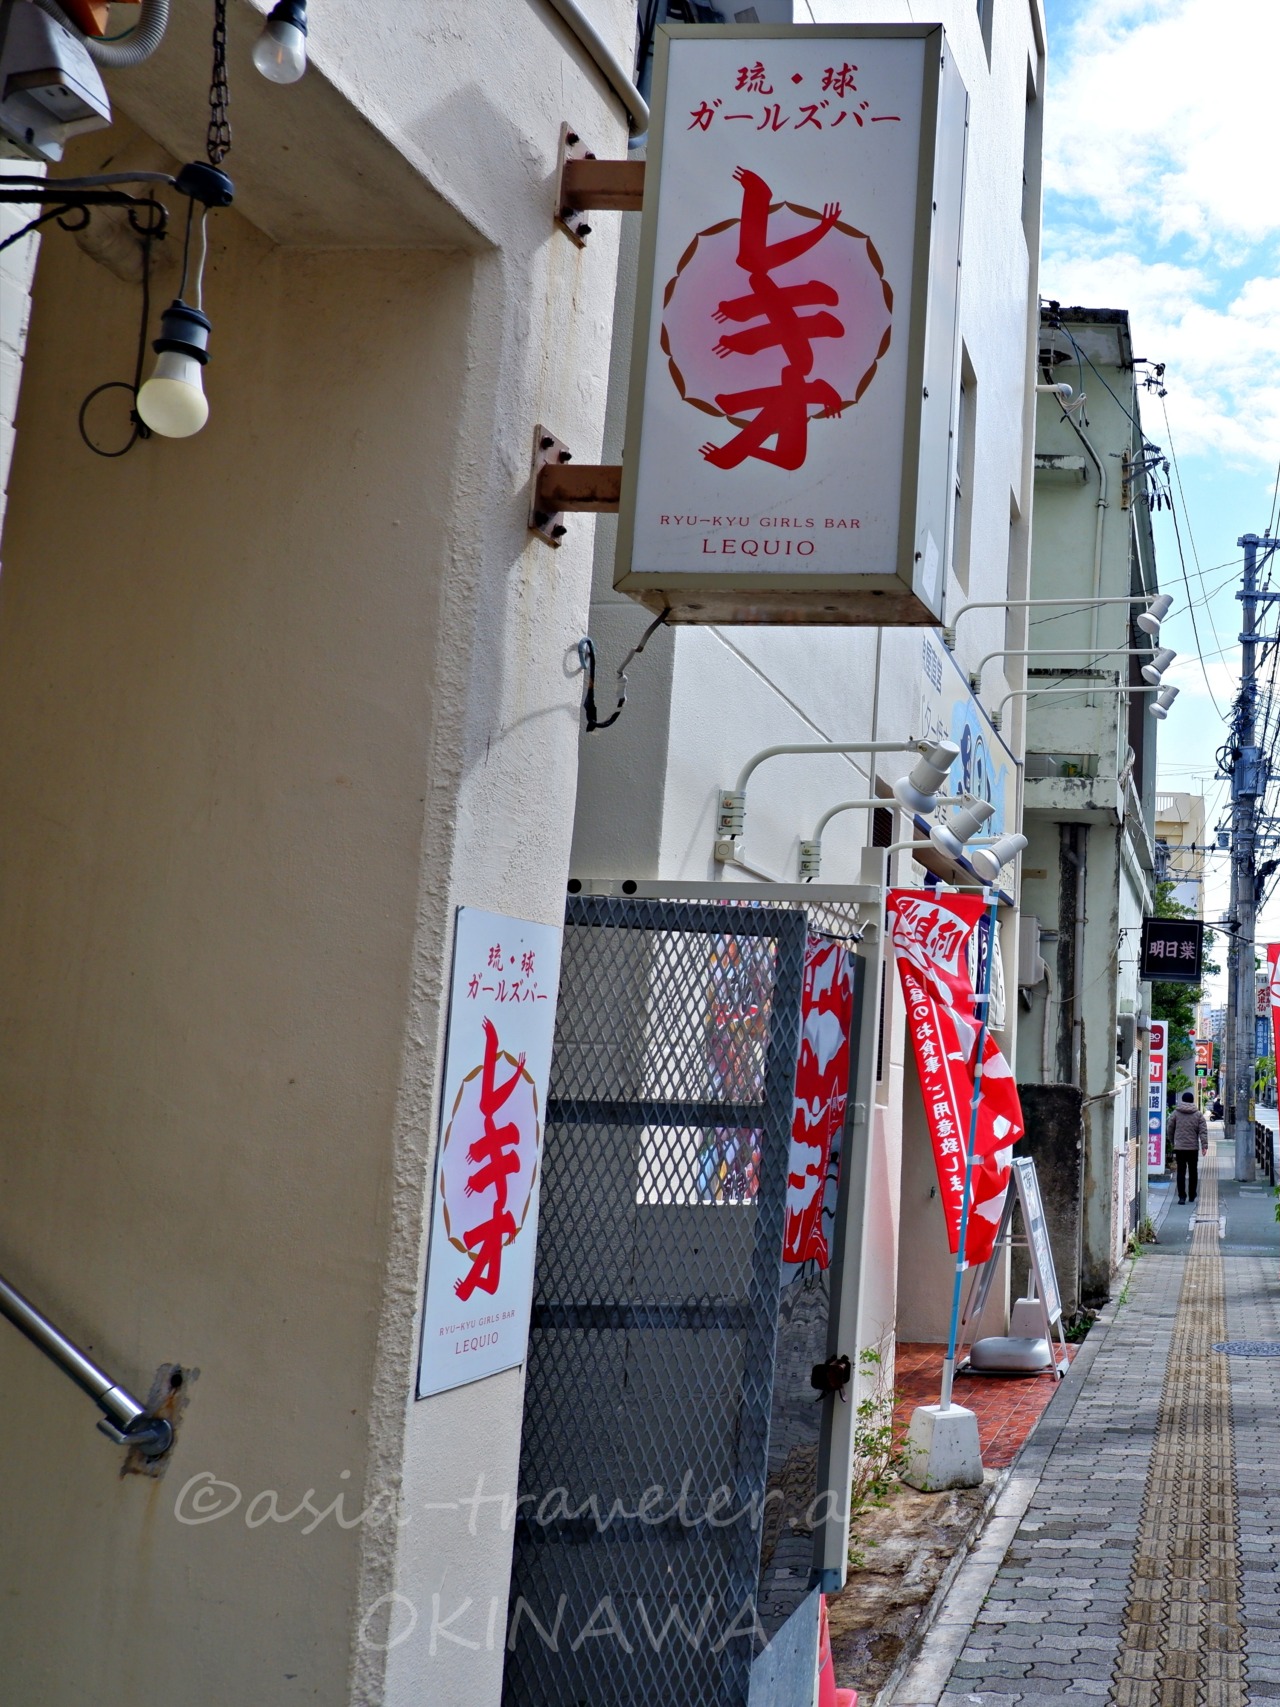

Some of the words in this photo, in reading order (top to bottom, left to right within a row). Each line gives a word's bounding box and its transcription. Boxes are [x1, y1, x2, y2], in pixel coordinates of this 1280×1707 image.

[687, 101, 901, 132] ガールズバー
[698, 165, 846, 471] レキオ
[660, 515, 750, 527] RYU-KYU
[759, 517, 815, 529] GIRLS
[824, 519, 861, 529] BAR
[702, 537, 816, 557] LEQUIO
[1149, 940, 1196, 960] 明日葉
[466, 973, 548, 1003] ガールズバー
[453, 1016, 527, 1301] レキオ
[479, 1313, 500, 1326] GIRLS
[502, 1310, 515, 1320] BAR
[455, 1331, 499, 1354] LEQUIO
